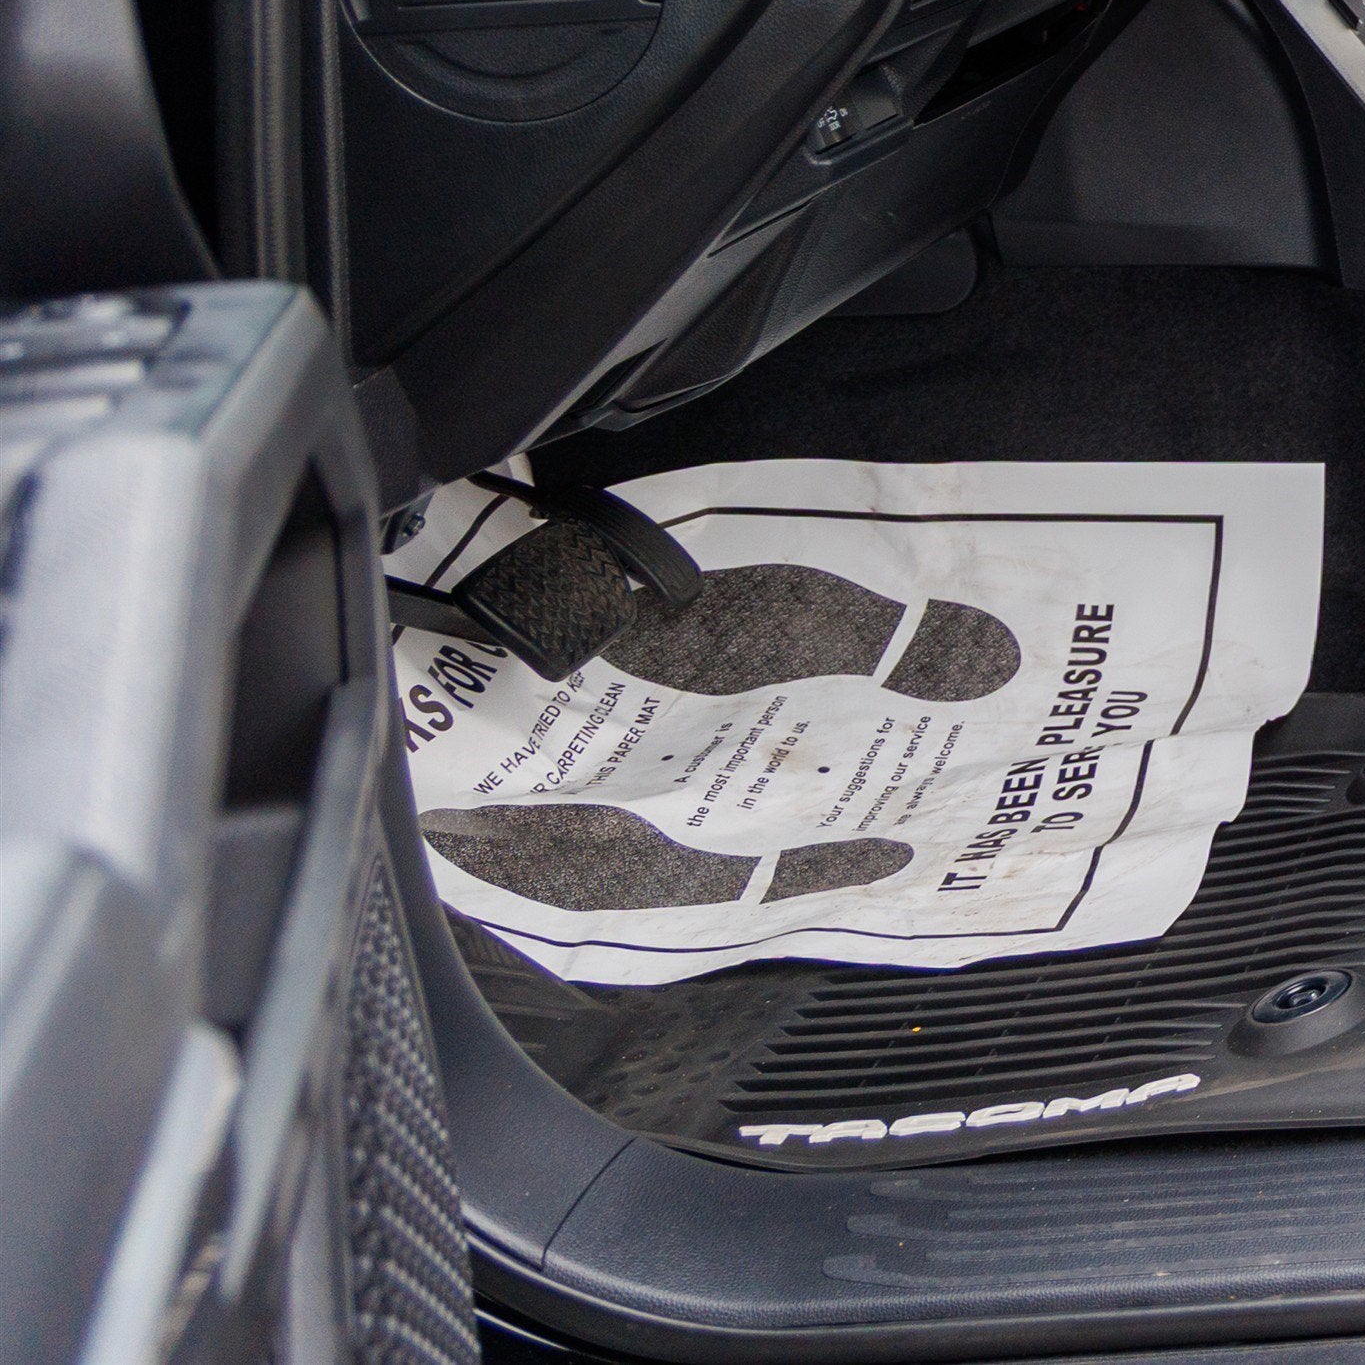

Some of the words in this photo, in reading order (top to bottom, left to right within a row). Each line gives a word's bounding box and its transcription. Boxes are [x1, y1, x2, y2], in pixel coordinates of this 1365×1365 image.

[427, 644, 498, 709] FOR
[1035, 603, 1115, 747] PLEASURE
[473, 771, 504, 795] WE
[500, 737, 541, 774] HAVE
[532, 705, 562, 740] TRIED
[552, 690, 571, 707] TO
[546, 713, 605, 785] CARPETING
[607, 726, 646, 763] PAPER
[635, 696, 661, 725] MAT
[674, 773, 691, 784] A
[684, 734, 726, 774] customer
[720, 721, 734, 737] is
[687, 806, 710, 828] the
[703, 774, 731, 802] most
[723, 727, 763, 774] important
[758, 694, 789, 728] person
[737, 798, 755, 811] in
[749, 777, 770, 797] the
[762, 747, 791, 775] world
[783, 736, 799, 749] to
[792, 720, 811, 736] us.
[929, 720, 966, 775] welcome.
[1030, 811, 1084, 834] TO
[1091, 690, 1149, 739] YOU
[816, 804, 844, 830] Your
[839, 737, 886, 805] suggestions
[878, 716, 896, 735] for
[851, 784, 899, 833] improving
[891, 761, 909, 783] our
[902, 715, 932, 761] service
[987, 756, 1051, 825] BEEN
[937, 872, 988, 892] IT
[954, 828, 1018, 863] HAS
[738, 1072, 1201, 1146] TACOMA
